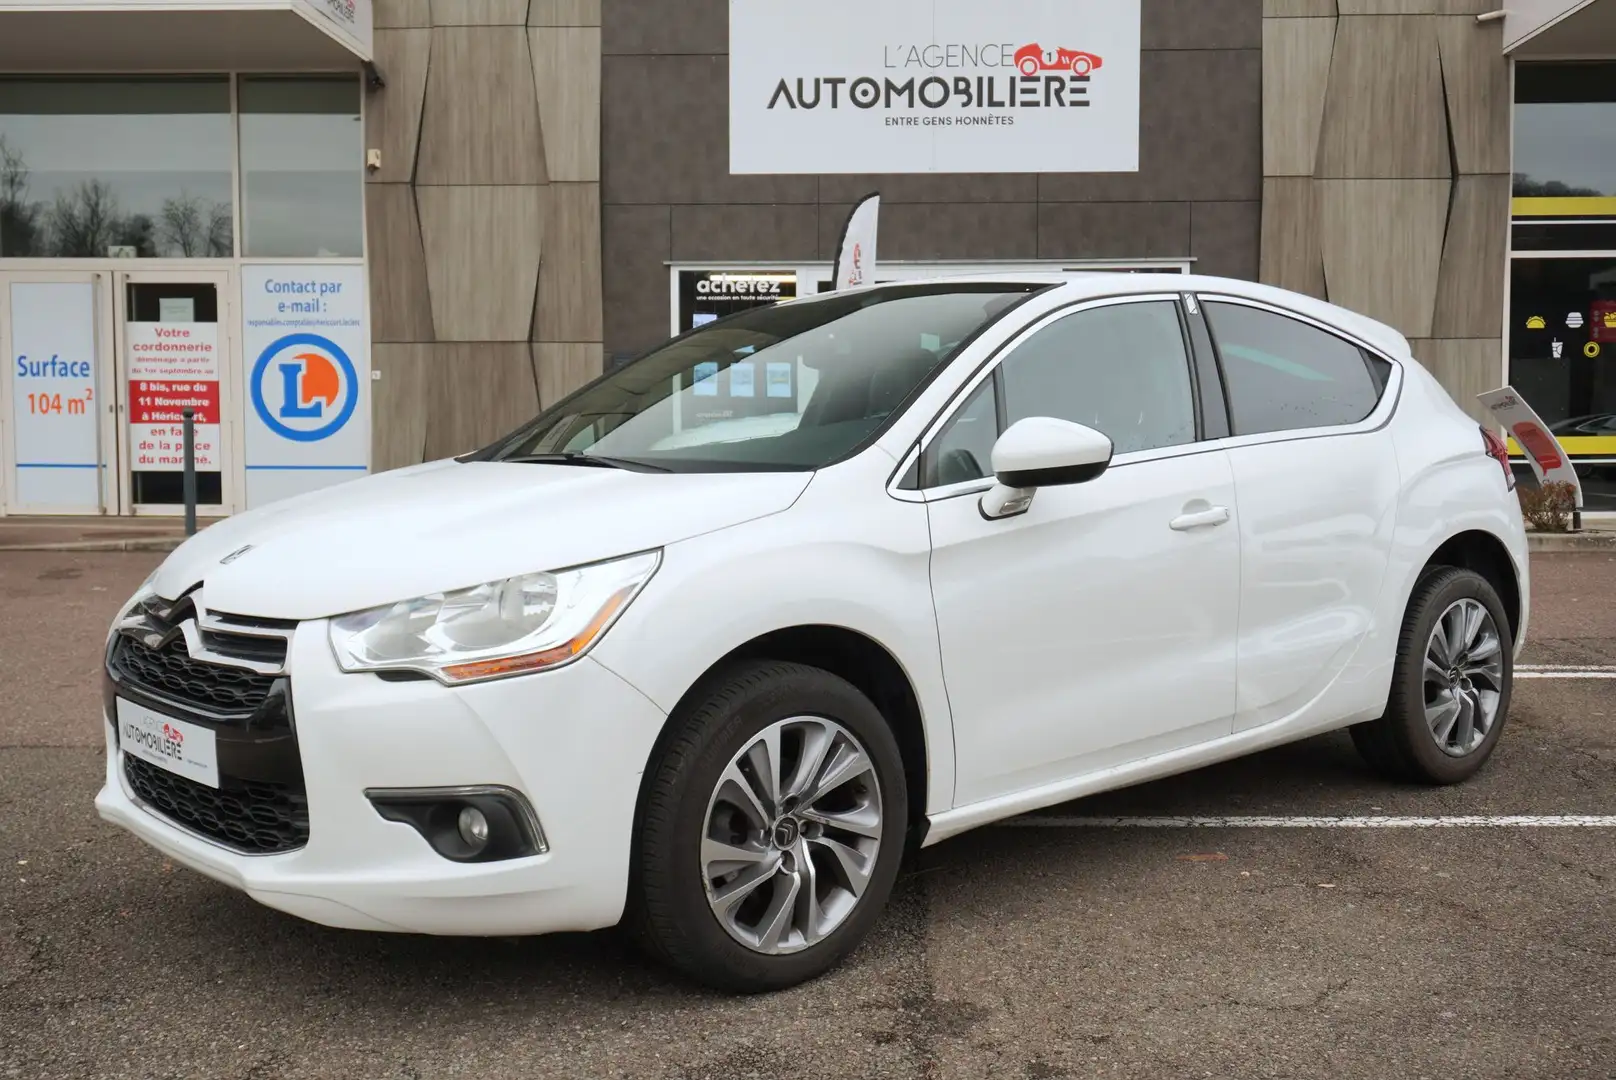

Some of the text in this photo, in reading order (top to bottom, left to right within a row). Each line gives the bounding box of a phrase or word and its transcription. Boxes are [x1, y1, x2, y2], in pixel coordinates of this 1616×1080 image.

[885, 114, 1014, 126] ENTRE GENS HONNÊTES
[264, 278, 342, 297] Contact par
[696, 273, 781, 293] achetez
[277, 298, 320, 313] e-mail
[154, 327, 191, 338] Votre
[132, 341, 213, 352] cordonnerie
[17, 353, 91, 378] Surface
[139, 382, 208, 392] 8 bis, rue du
[28, 393, 62, 415] 104
[138, 396, 211, 407] 11 Novembre
[141, 411, 150, 421] à
[170, 426, 199, 437] fae
[138, 441, 212, 452] de la pce
[138, 455, 155, 464] du
